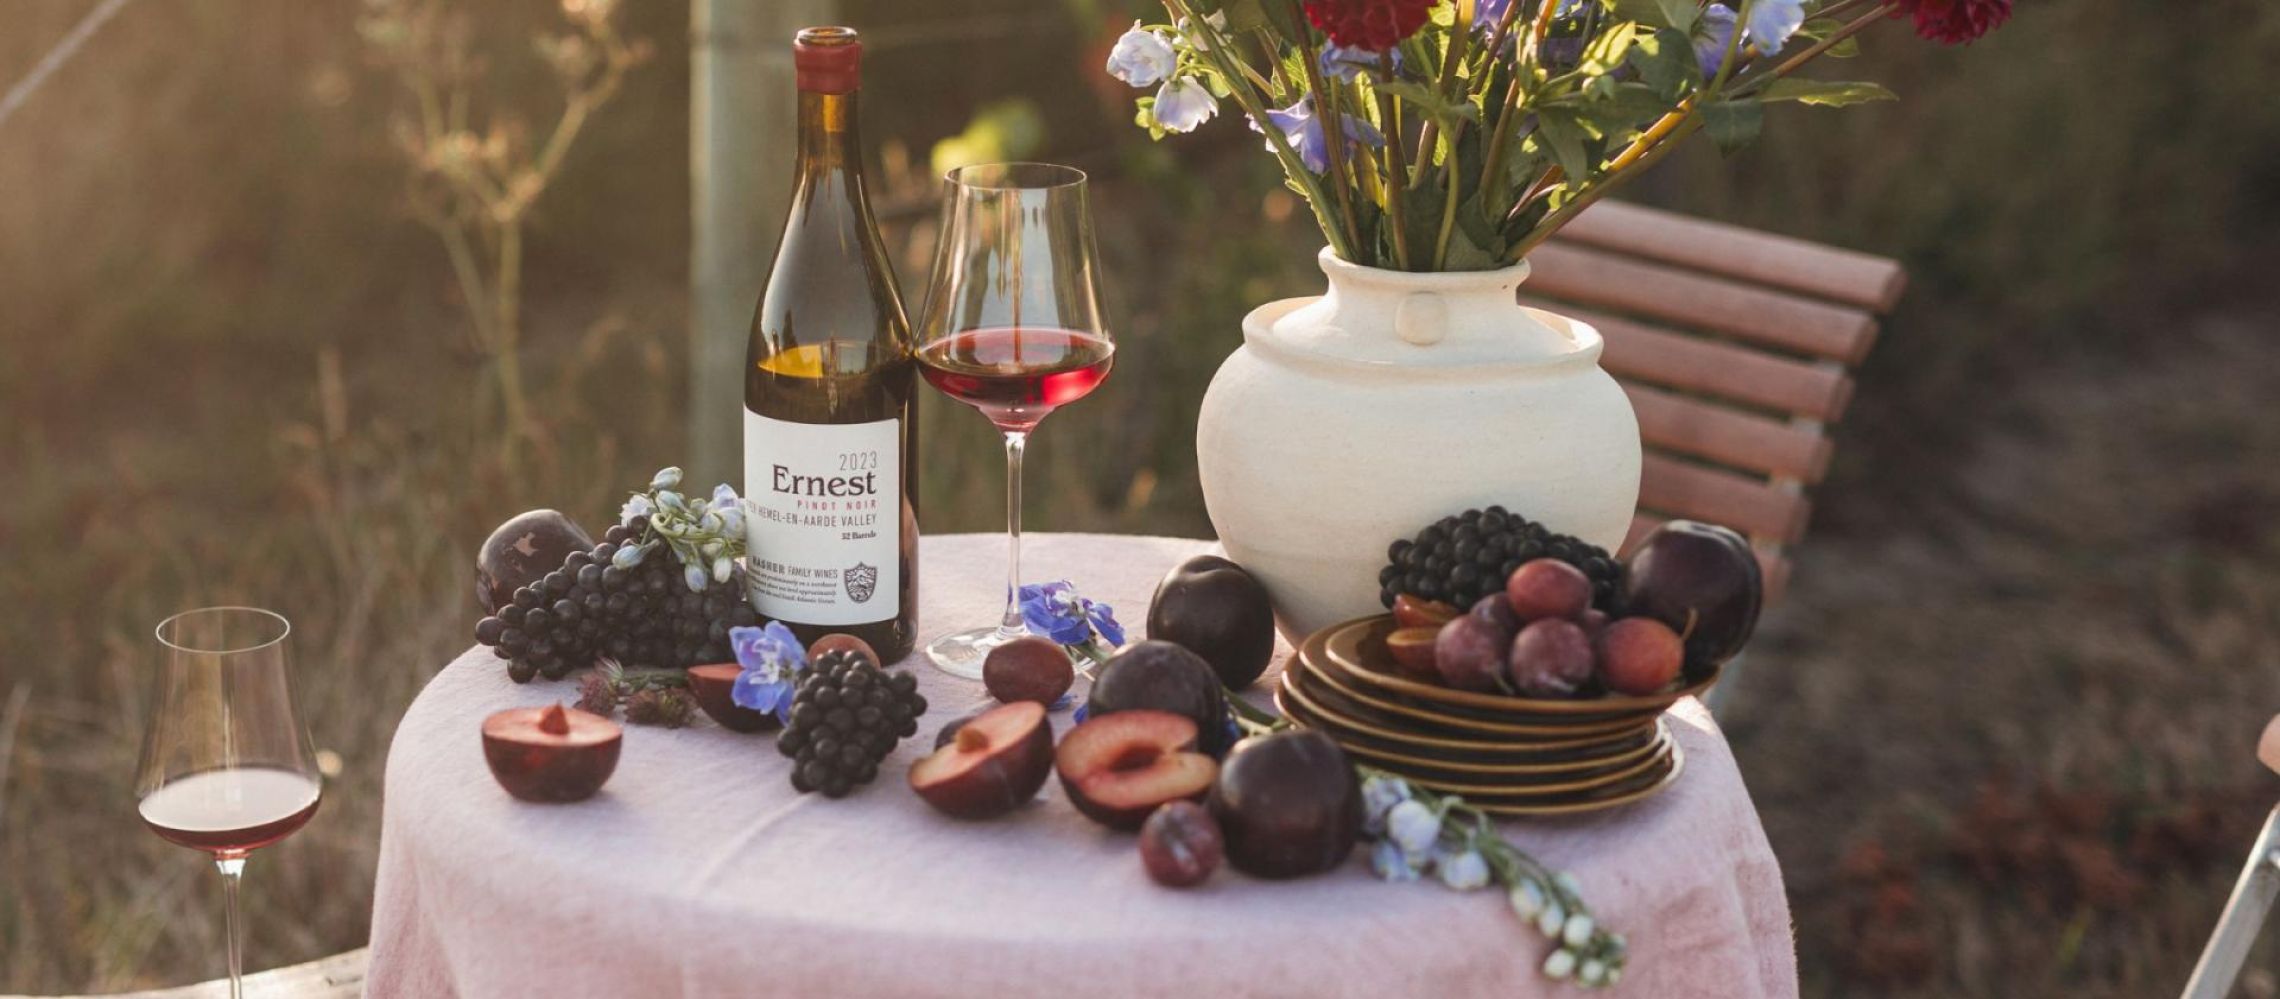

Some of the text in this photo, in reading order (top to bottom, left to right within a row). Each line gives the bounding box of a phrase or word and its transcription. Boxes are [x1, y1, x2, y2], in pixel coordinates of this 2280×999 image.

[839, 451, 878, 471] 2023
[772, 463, 877, 497] Ernest
[797, 499, 877, 511] PINOT NOIR
[841, 513, 877, 527] VALLEY
[788, 565, 812, 578] FAMILY
[814, 568, 839, 580] WINES
